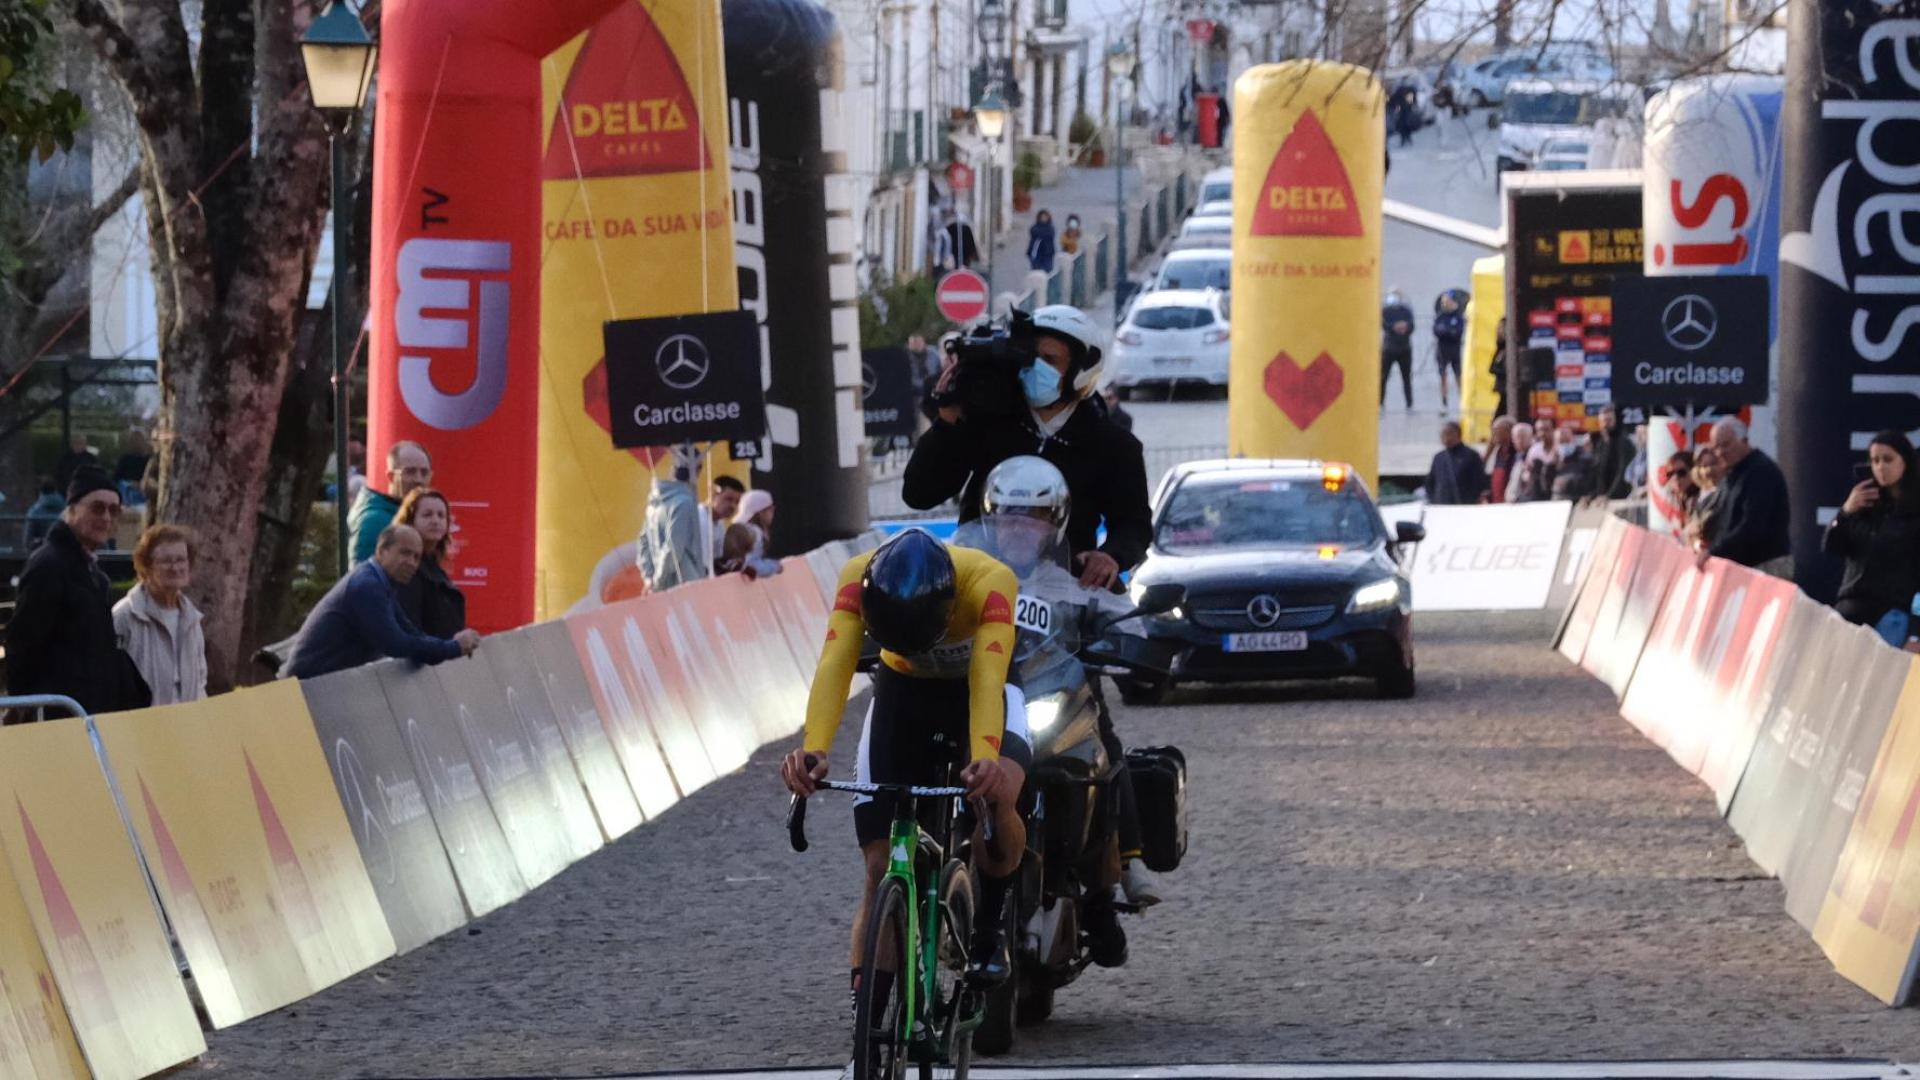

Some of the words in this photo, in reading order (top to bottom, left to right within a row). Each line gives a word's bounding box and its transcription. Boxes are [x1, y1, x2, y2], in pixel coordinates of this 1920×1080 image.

[572, 97, 688, 138] DELTA
[421, 187, 449, 230] TV
[1269, 186, 1347, 211] DELTA
[603, 217, 637, 239] DA
[643, 212, 688, 235] SUA
[1310, 264, 1342, 278] SUA
[1634, 361, 1745, 385] Carclasse
[633, 400, 741, 428] Carclasse
[1444, 541, 1550, 572] CUBE
[1017, 599, 1049, 630] 200
